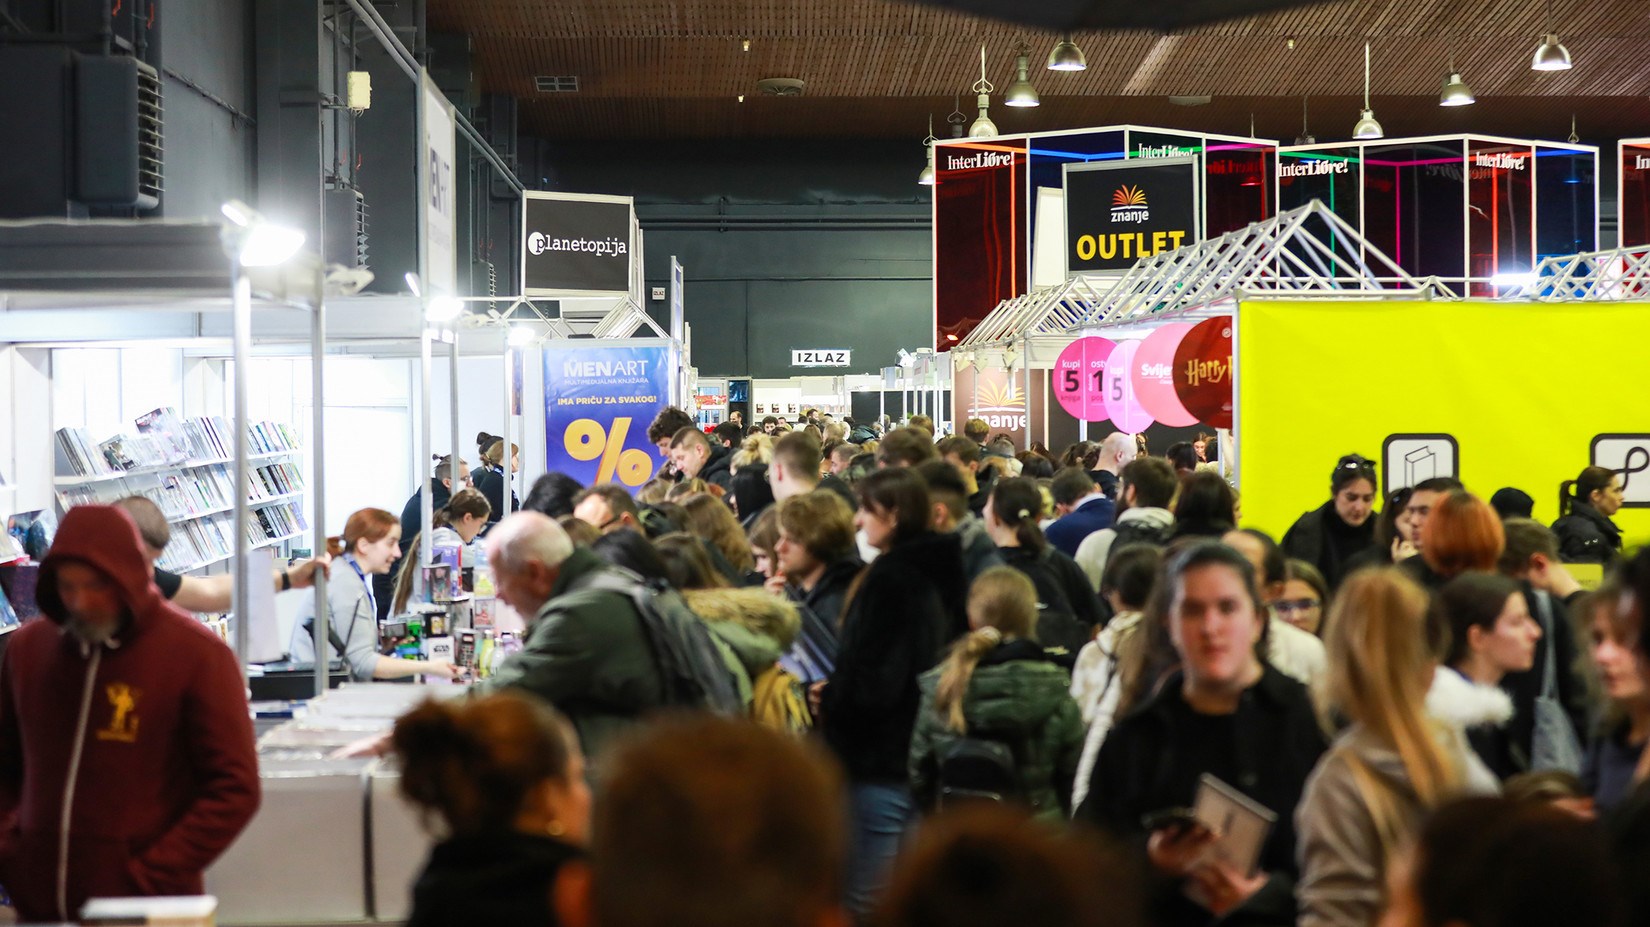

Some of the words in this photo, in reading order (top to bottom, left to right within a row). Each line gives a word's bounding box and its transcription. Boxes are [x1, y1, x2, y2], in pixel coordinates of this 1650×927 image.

[1111, 210, 1149, 224] znanje
[528, 232, 627, 257] planetopija
[1076, 231, 1185, 260] OUTLET
[798, 352, 845, 363] IZLAZ
[1062, 360, 1080, 370] kupi
[563, 360, 648, 377] MENART
[1184, 358, 1226, 386] Harry
[1065, 370, 1079, 392] 5
[1093, 370, 1103, 392] 1
[1112, 377, 1123, 401] 5
[576, 395, 602, 405] PRIČU
[604, 396, 617, 404] ZA
[618, 395, 657, 404] SVAKOG!
[968, 415, 1026, 432] nanje
